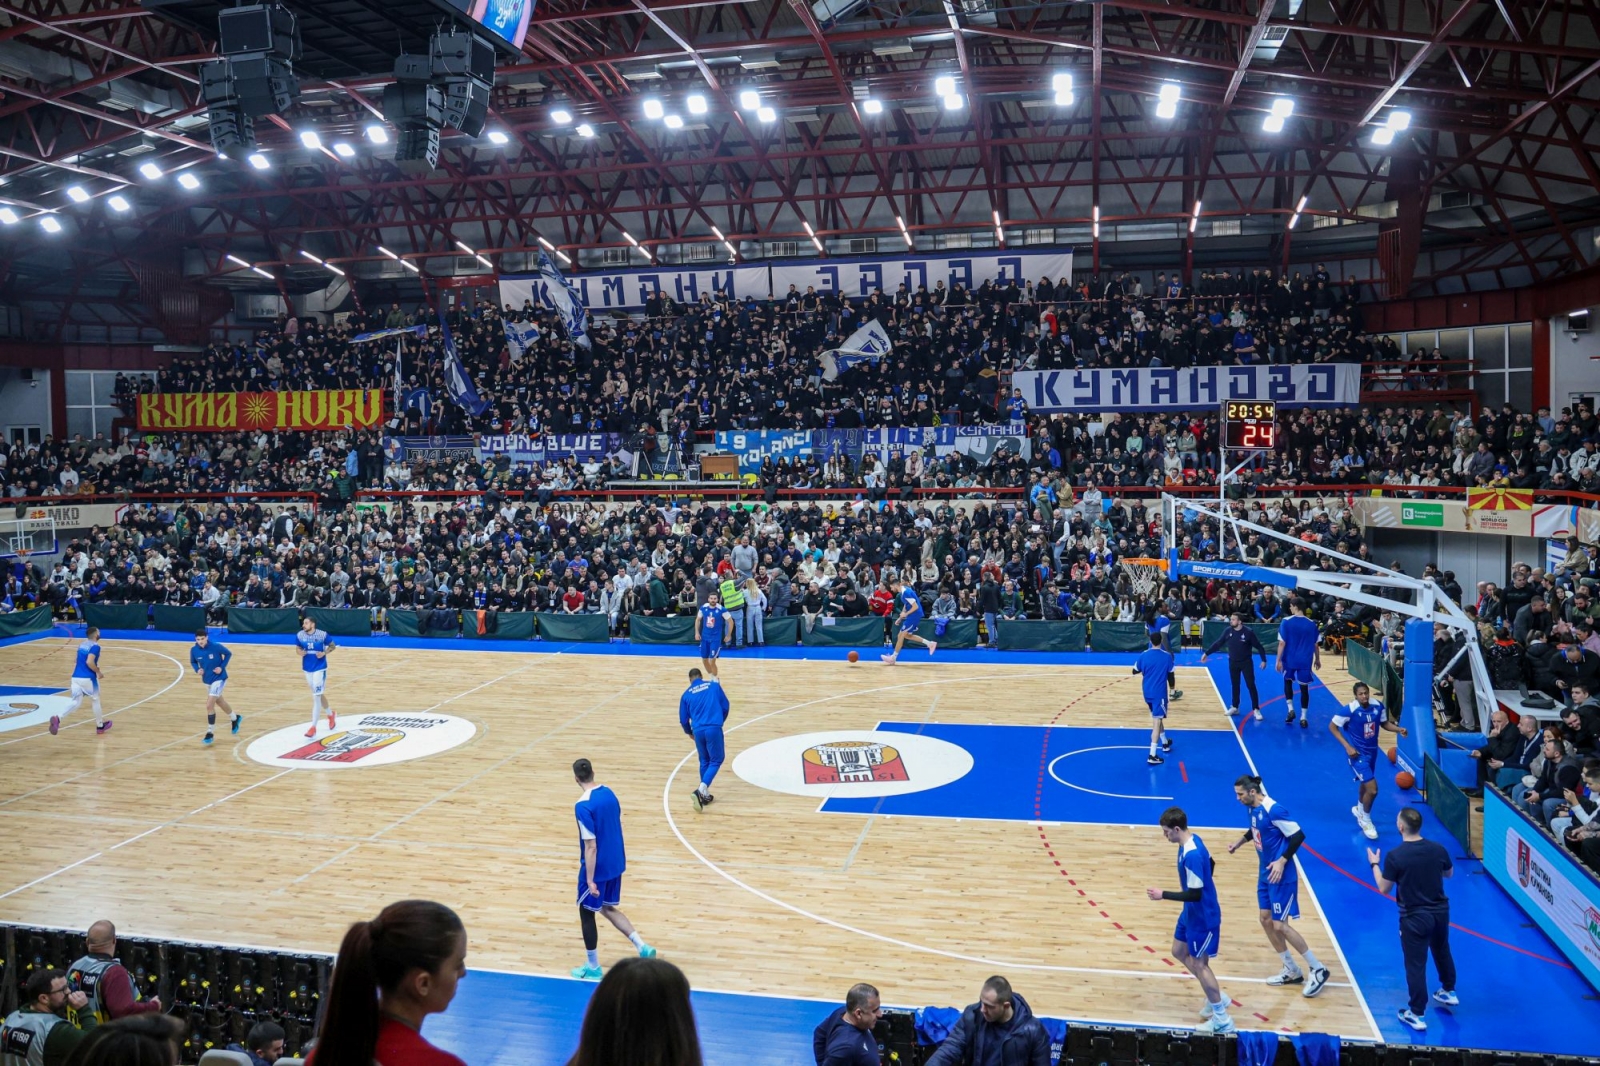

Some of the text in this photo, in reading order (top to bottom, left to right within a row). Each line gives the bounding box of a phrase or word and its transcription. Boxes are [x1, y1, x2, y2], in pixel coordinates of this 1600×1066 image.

[1035, 365, 1335, 408] КУМАНОВО
[140, 393, 237, 428] КУМА
[1228, 404, 1273, 418] 20:54
[956, 426, 1024, 436] КУМАНИ
[1243, 425, 1273, 446] 24
[547, 435, 602, 451] BLUE
[48, 507, 79, 520] MKD
[1273, 903, 1281, 914] 19
[12, 1031, 30, 1044] FIBA
